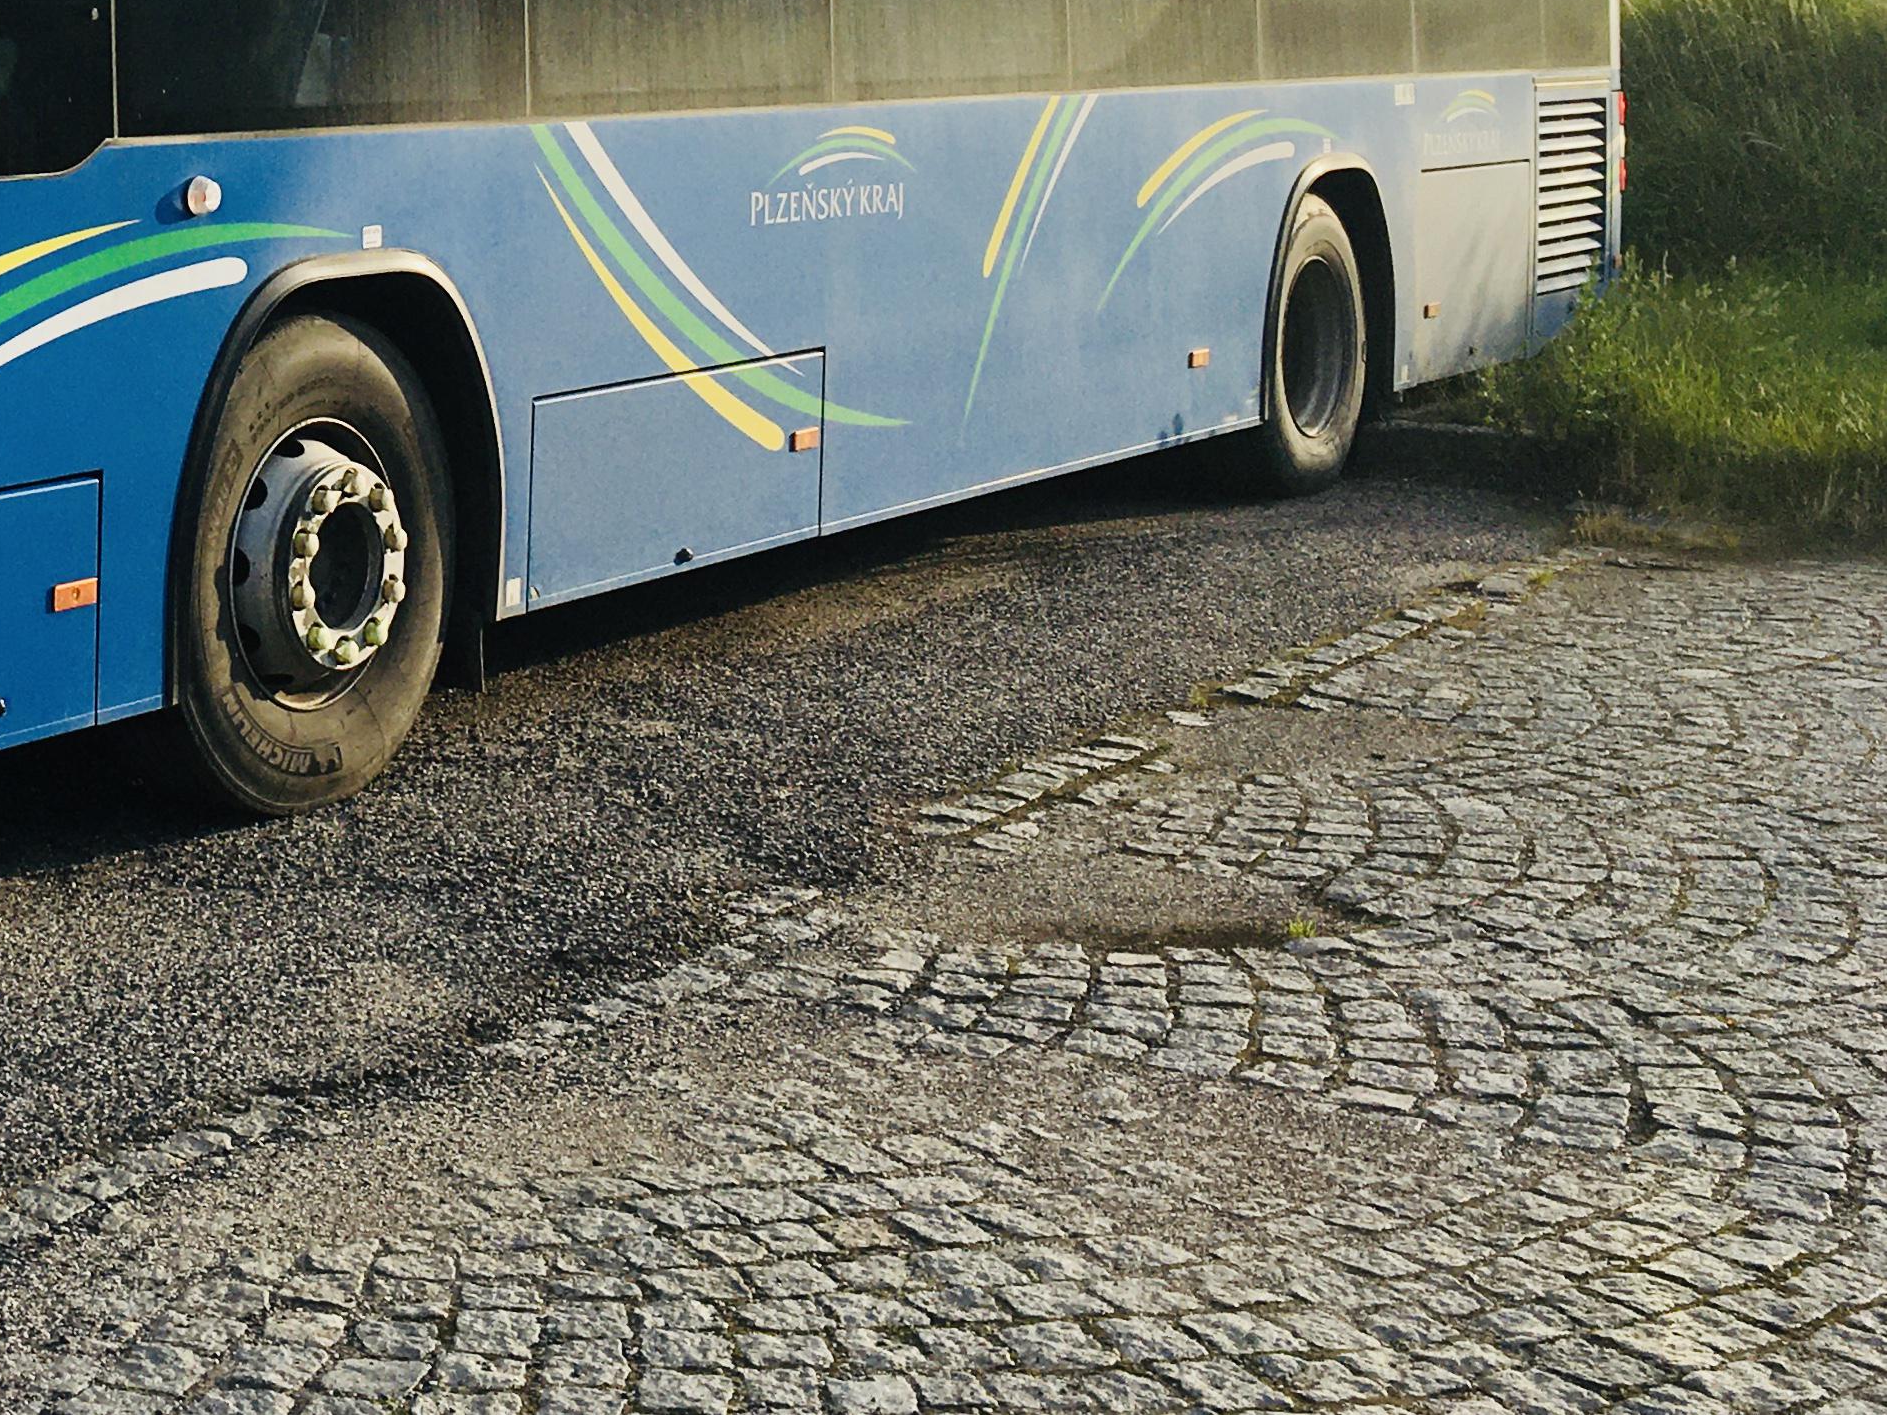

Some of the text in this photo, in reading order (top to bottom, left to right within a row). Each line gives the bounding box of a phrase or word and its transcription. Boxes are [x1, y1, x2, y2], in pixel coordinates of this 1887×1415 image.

[750, 178, 904, 227] PLZEŇSKÝ KRAJ
[221, 691, 312, 775] MICHELIN
